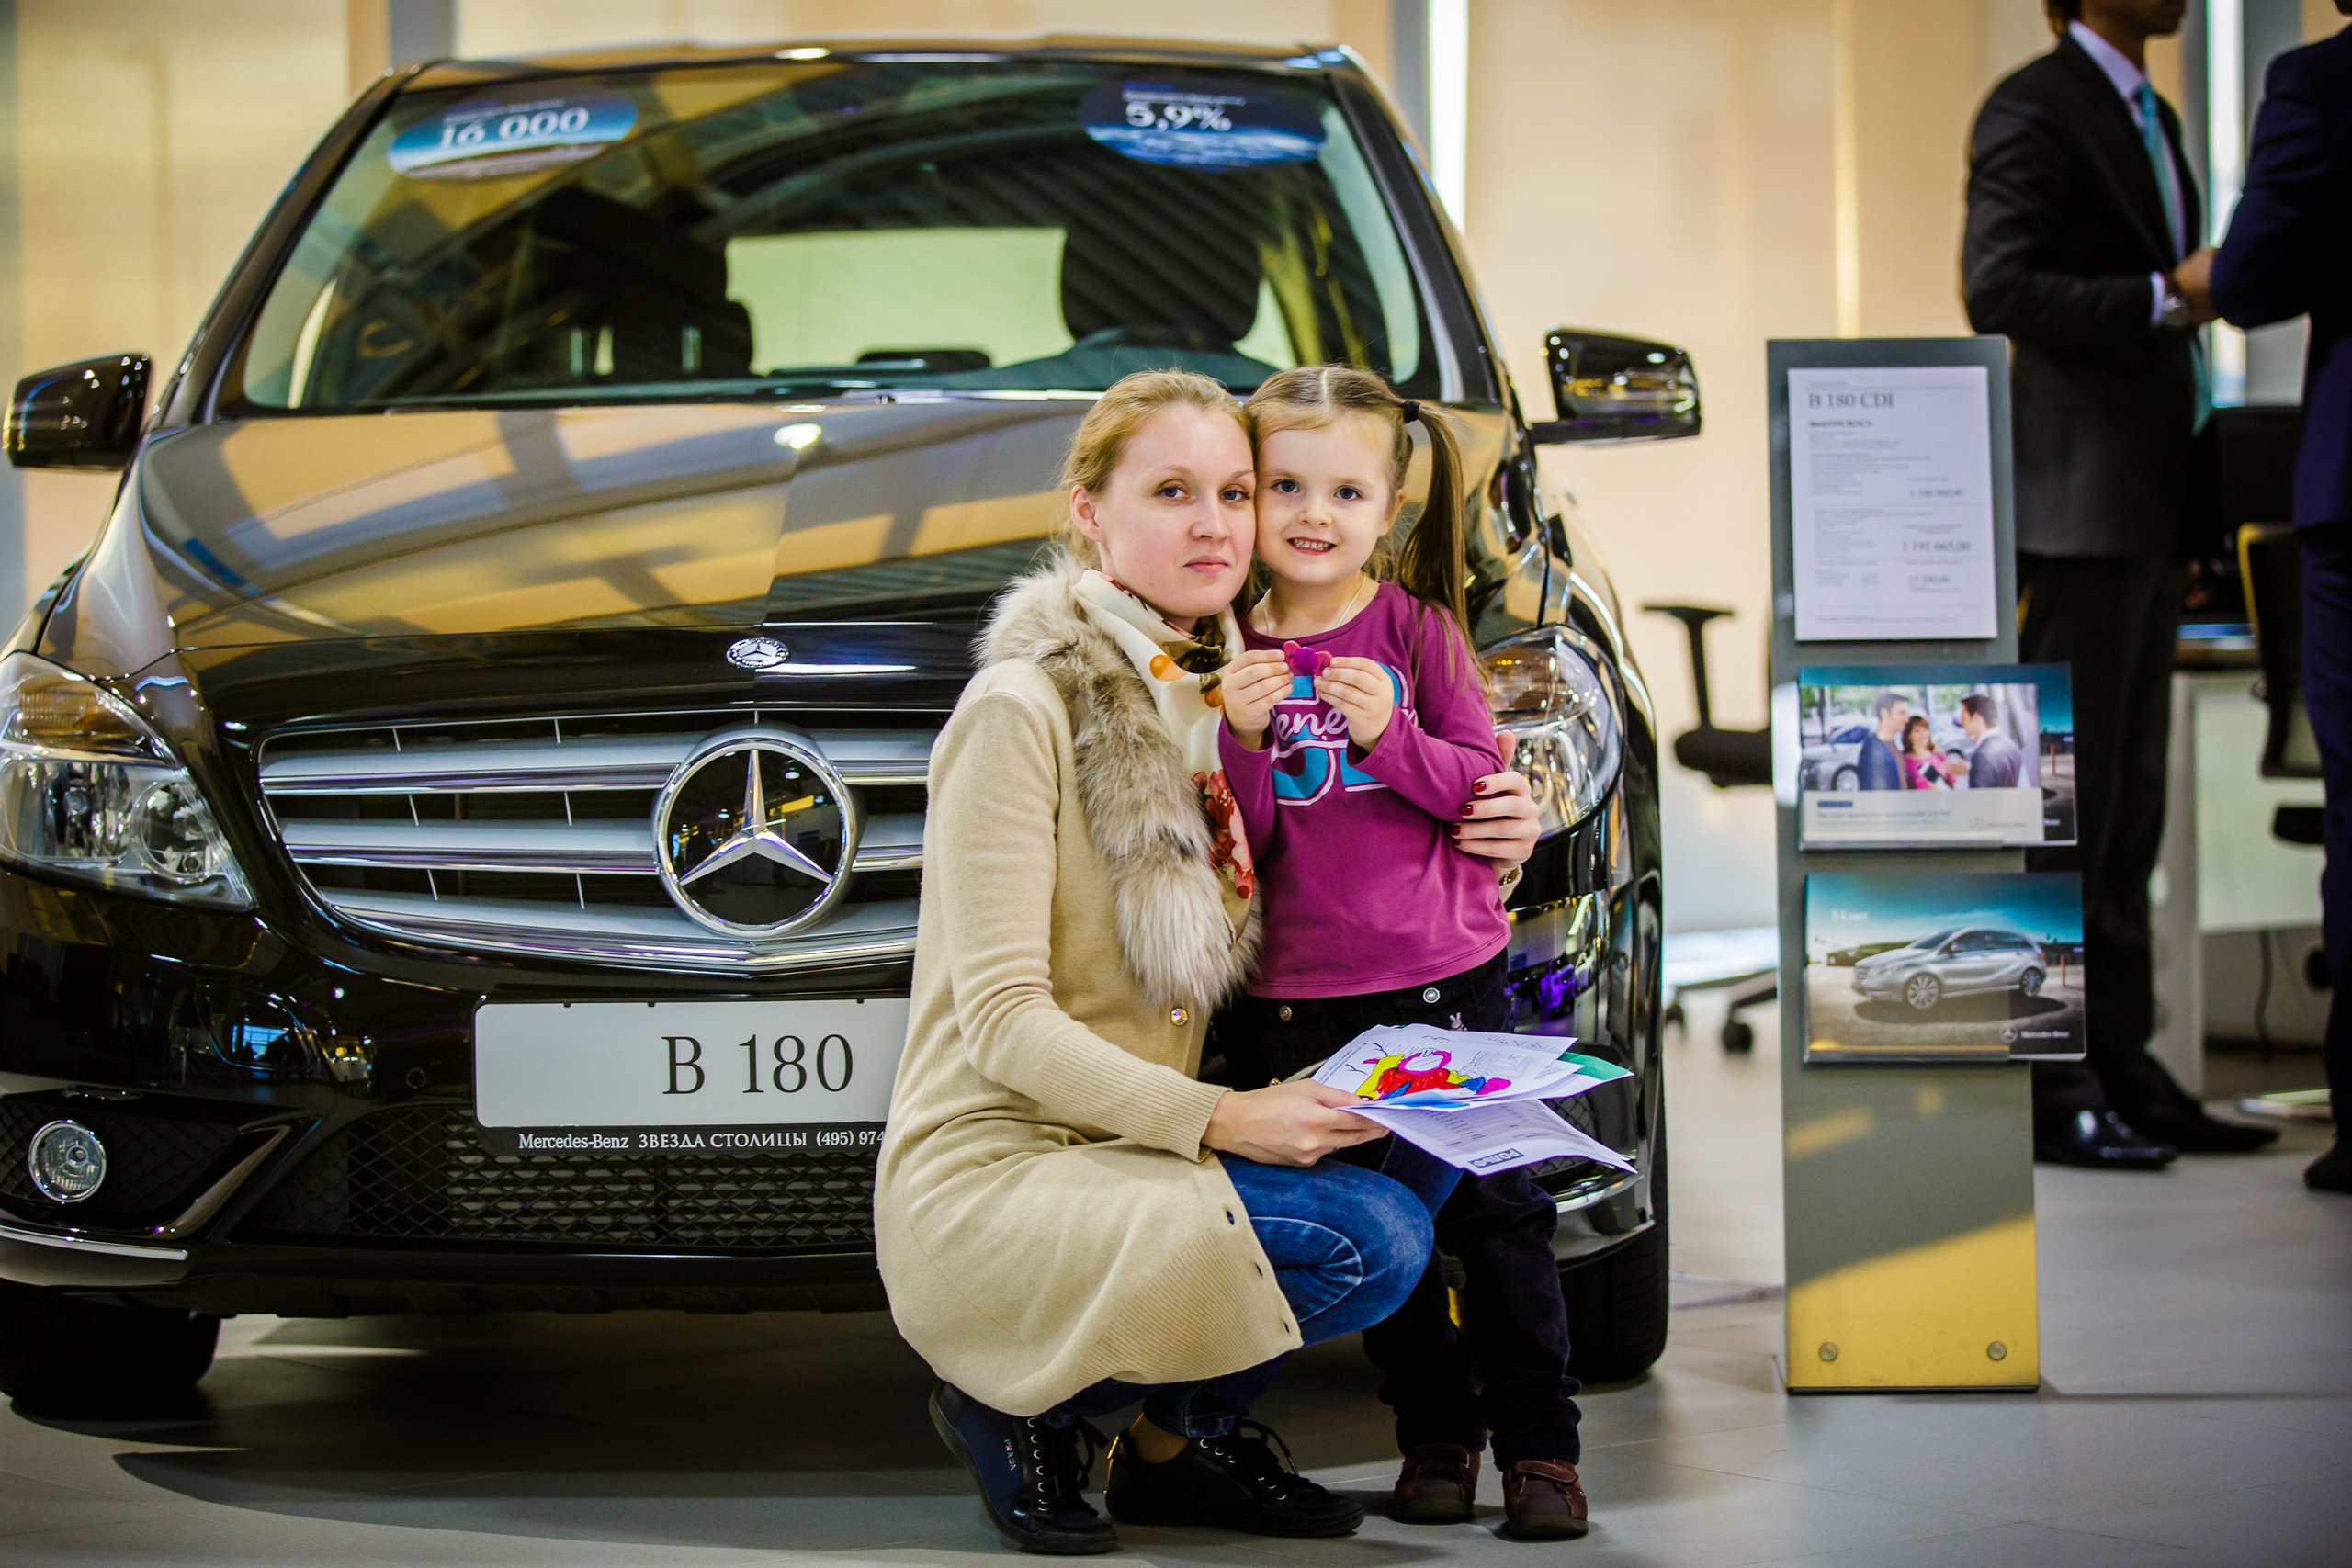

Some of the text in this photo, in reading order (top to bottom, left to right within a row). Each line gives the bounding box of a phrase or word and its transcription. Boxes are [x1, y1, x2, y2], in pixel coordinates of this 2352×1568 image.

[498, 107, 590, 140] 000
[1125, 101, 1232, 132] 5,9%
[1808, 391, 1894, 409] B 180 CDI
[661, 1033, 854, 1095] B 180
[517, 1132, 629, 1150] Mercedes-Benz
[638, 1133, 707, 1149] ЗВЕЗДА
[710, 1132, 808, 1150] СТОЛИЦЫ
[816, 1130, 854, 1147] (495)
[1004, 1439, 1016, 1471] PRADA
